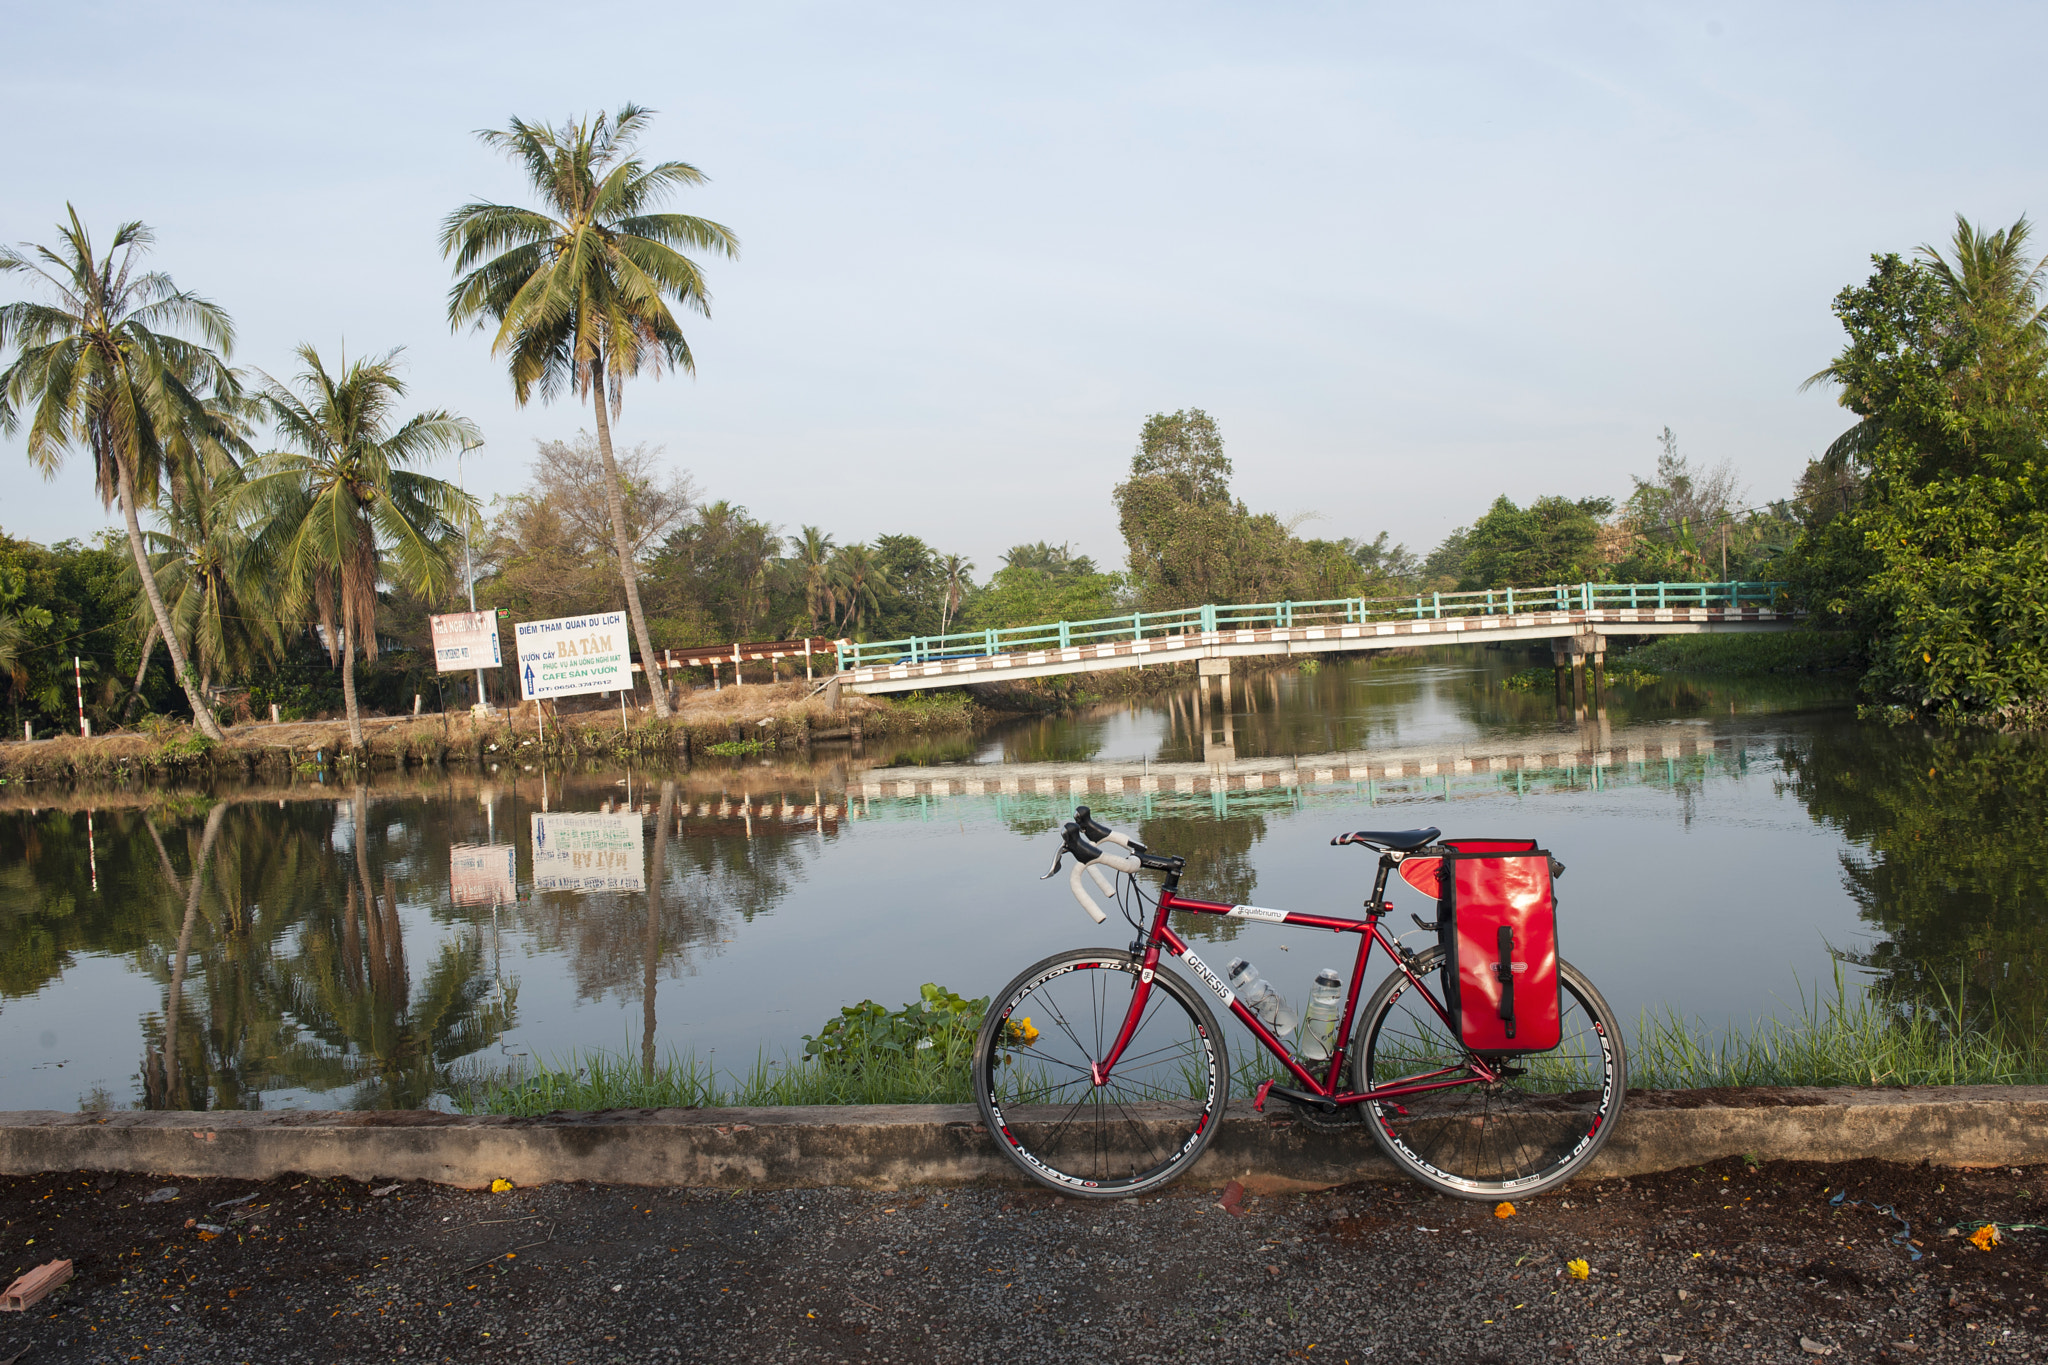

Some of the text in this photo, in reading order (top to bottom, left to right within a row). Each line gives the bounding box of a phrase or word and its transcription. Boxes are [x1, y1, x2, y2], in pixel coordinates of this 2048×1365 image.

[540, 622, 562, 632] THAM
[566, 620, 586, 629] QUAN
[590, 618, 599, 626] DU
[603, 616, 619, 626] LỊCH
[557, 633, 613, 657] BA TÂM
[542, 672, 568, 681] CAFE
[1011, 965, 1074, 1008] EASTON
[1187, 955, 1230, 998] GENESIS
[1203, 1038, 1216, 1112] EASTON
[1600, 1036, 1613, 1115] EASTON
[1017, 1146, 1083, 1186] EASTON
[1394, 1138, 1462, 1184] EASTON
